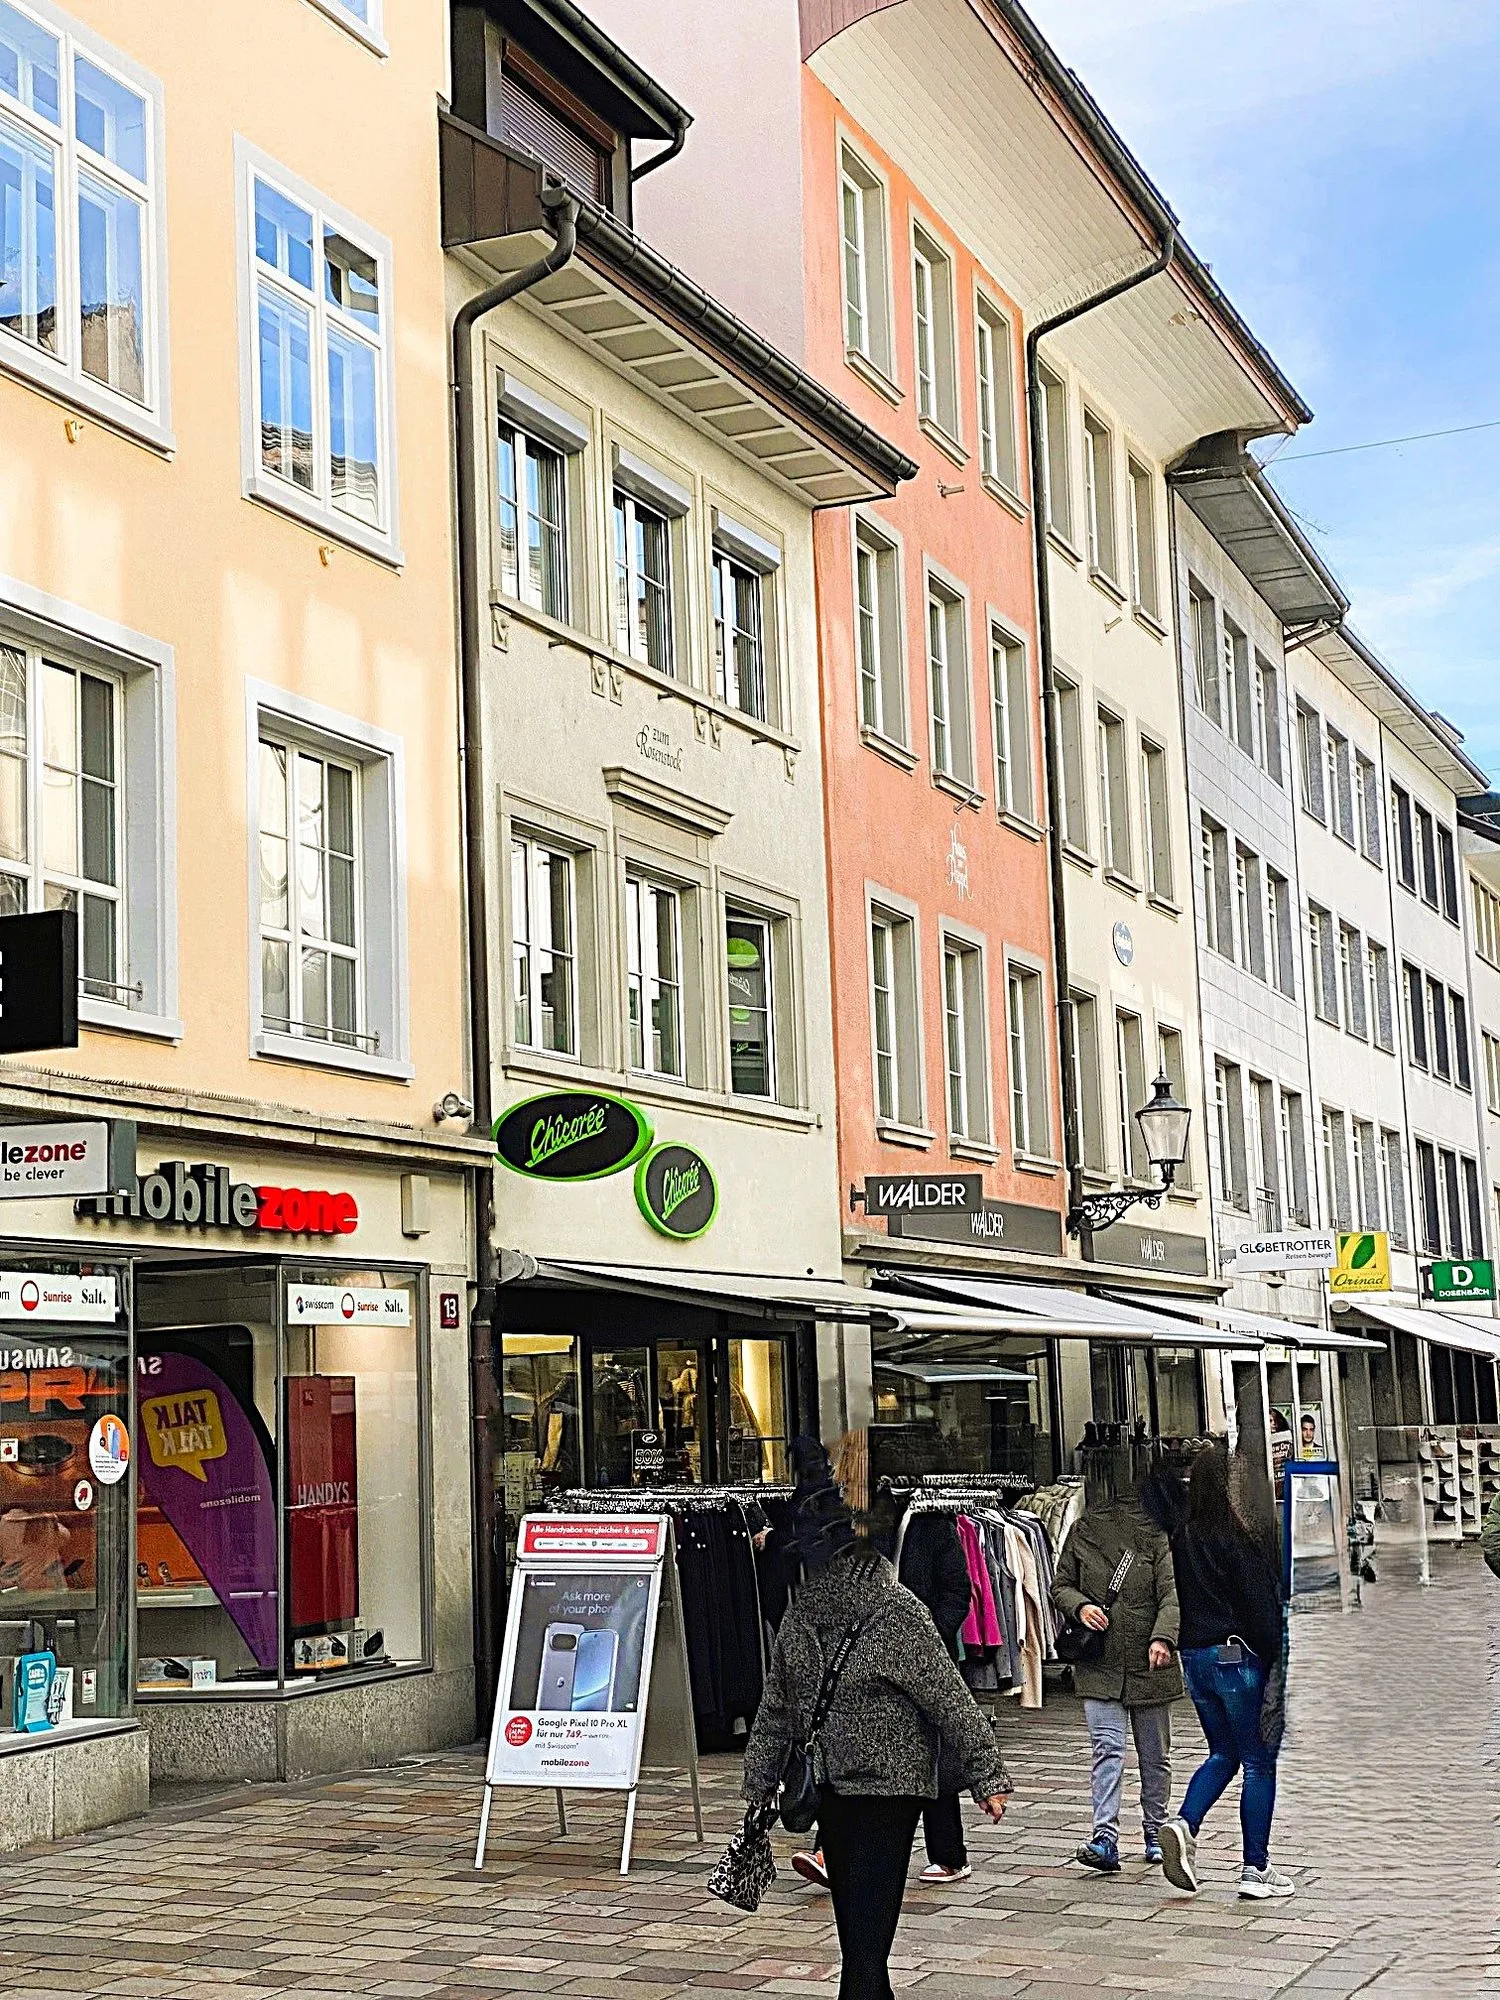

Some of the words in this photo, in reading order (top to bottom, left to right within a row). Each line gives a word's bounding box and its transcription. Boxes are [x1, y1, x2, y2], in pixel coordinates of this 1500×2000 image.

[652, 728, 670, 746] zum
[636, 724, 683, 772] Rosenstock
[4, 1169, 20, 1181] be
[25, 1168, 64, 1181] clever
[878, 1179, 966, 1209] WALDER
[970, 1205, 1004, 1238] WALDER
[1140, 1237, 1166, 1261] WALDER
[1240, 1240, 1332, 1254] GLOBETROTTER
[1451, 1265, 1474, 1287] D
[43, 1290, 72, 1303] Sunrise
[81, 1288, 107, 1305] Salt.
[304, 1298, 334, 1310] swisscom
[357, 1301, 379, 1312] Sunrise
[384, 1299, 403, 1313] Salt.
[443, 1297, 457, 1319] 13
[634, 1448, 665, 1465] 50%
[297, 1481, 350, 1505] HANDYS
[531, 1525, 545, 1533] Alle
[545, 1525, 583, 1534] Handyabos
[584, 1526, 622, 1535] vergleichen
[624, 1526, 630, 1534] &
[562, 1591, 583, 1601] Ask
[583, 1592, 611, 1601] more
[549, 1604, 562, 1614] of
[563, 1606, 586, 1615] your
[538, 1717, 568, 1729] Google
[569, 1719, 589, 1728] Pixel
[590, 1719, 598, 1727] 10
[601, 1719, 615, 1728] Pro
[616, 1719, 628, 1728] XL
[536, 1728, 548, 1738] für
[549, 1731, 563, 1739] nur
[535, 1741, 546, 1749] mit
[540, 1758, 590, 1767] mobilezone
